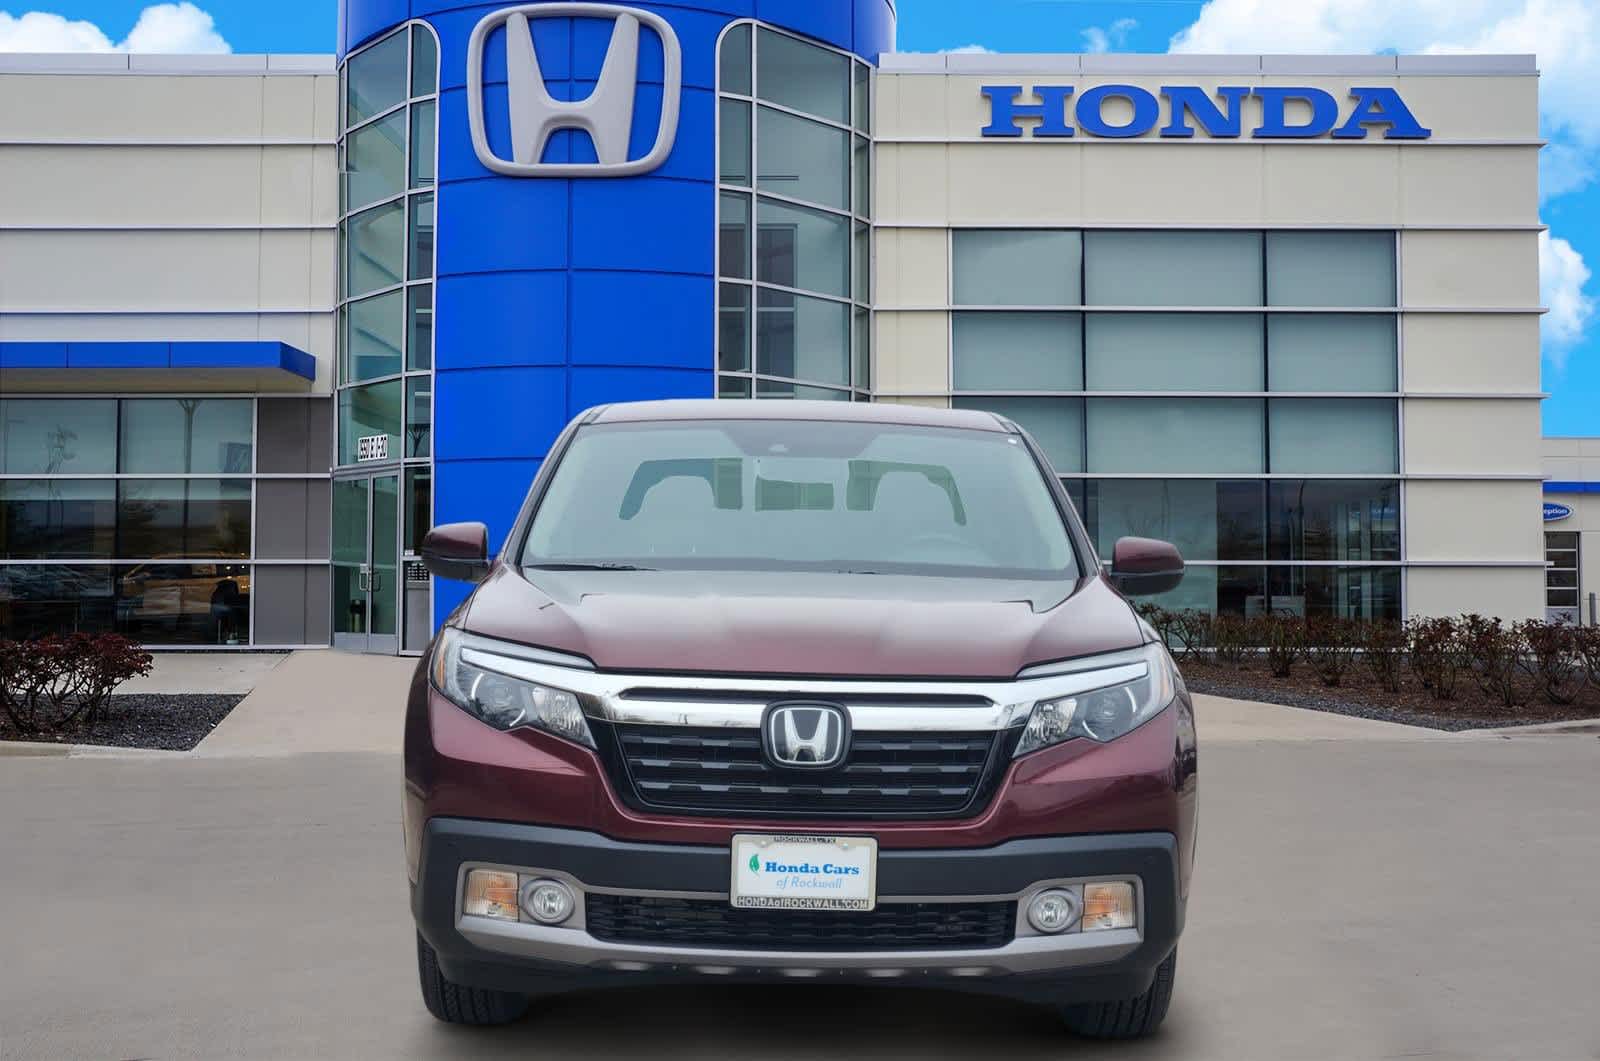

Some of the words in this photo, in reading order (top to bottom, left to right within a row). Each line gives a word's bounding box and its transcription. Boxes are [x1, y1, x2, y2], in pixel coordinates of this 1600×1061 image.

[981, 85, 1431, 139] HONDA
[765, 861, 820, 874] Honda
[822, 863, 860, 875] Cars
[776, 875, 788, 889] of
[791, 876, 843, 889] Rockwall
